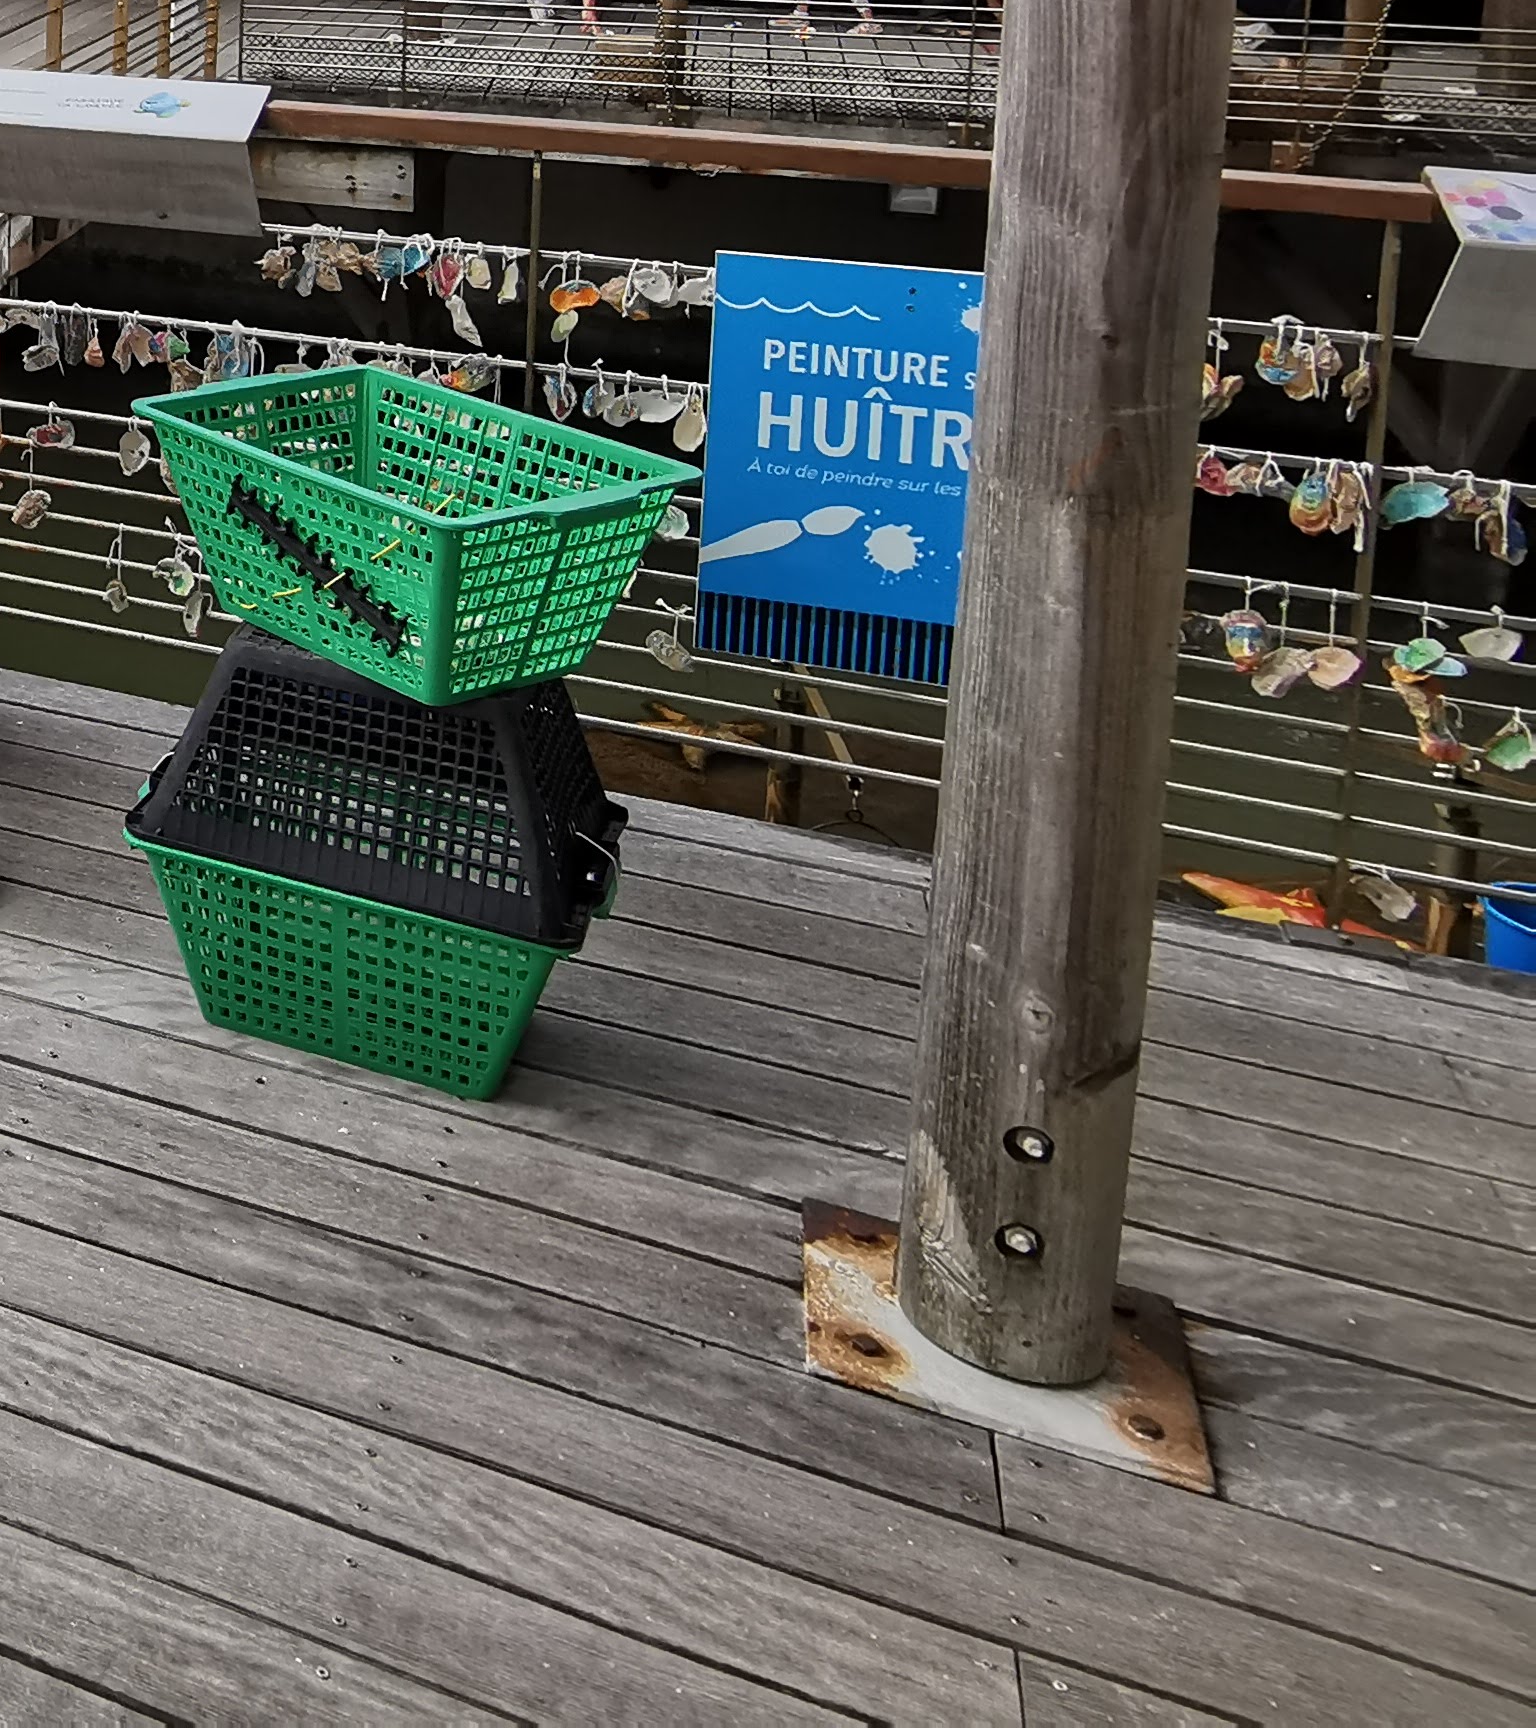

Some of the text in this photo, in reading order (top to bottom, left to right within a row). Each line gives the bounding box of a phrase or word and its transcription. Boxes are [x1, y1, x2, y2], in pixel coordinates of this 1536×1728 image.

[763, 338, 950, 388] PEINTURE
[757, 386, 973, 471] HUÎTR
[766, 463, 790, 476] toi
[794, 463, 819, 480] de
[821, 469, 894, 490] peindre
[897, 479, 930, 493] sur
[934, 480, 962, 497] les
